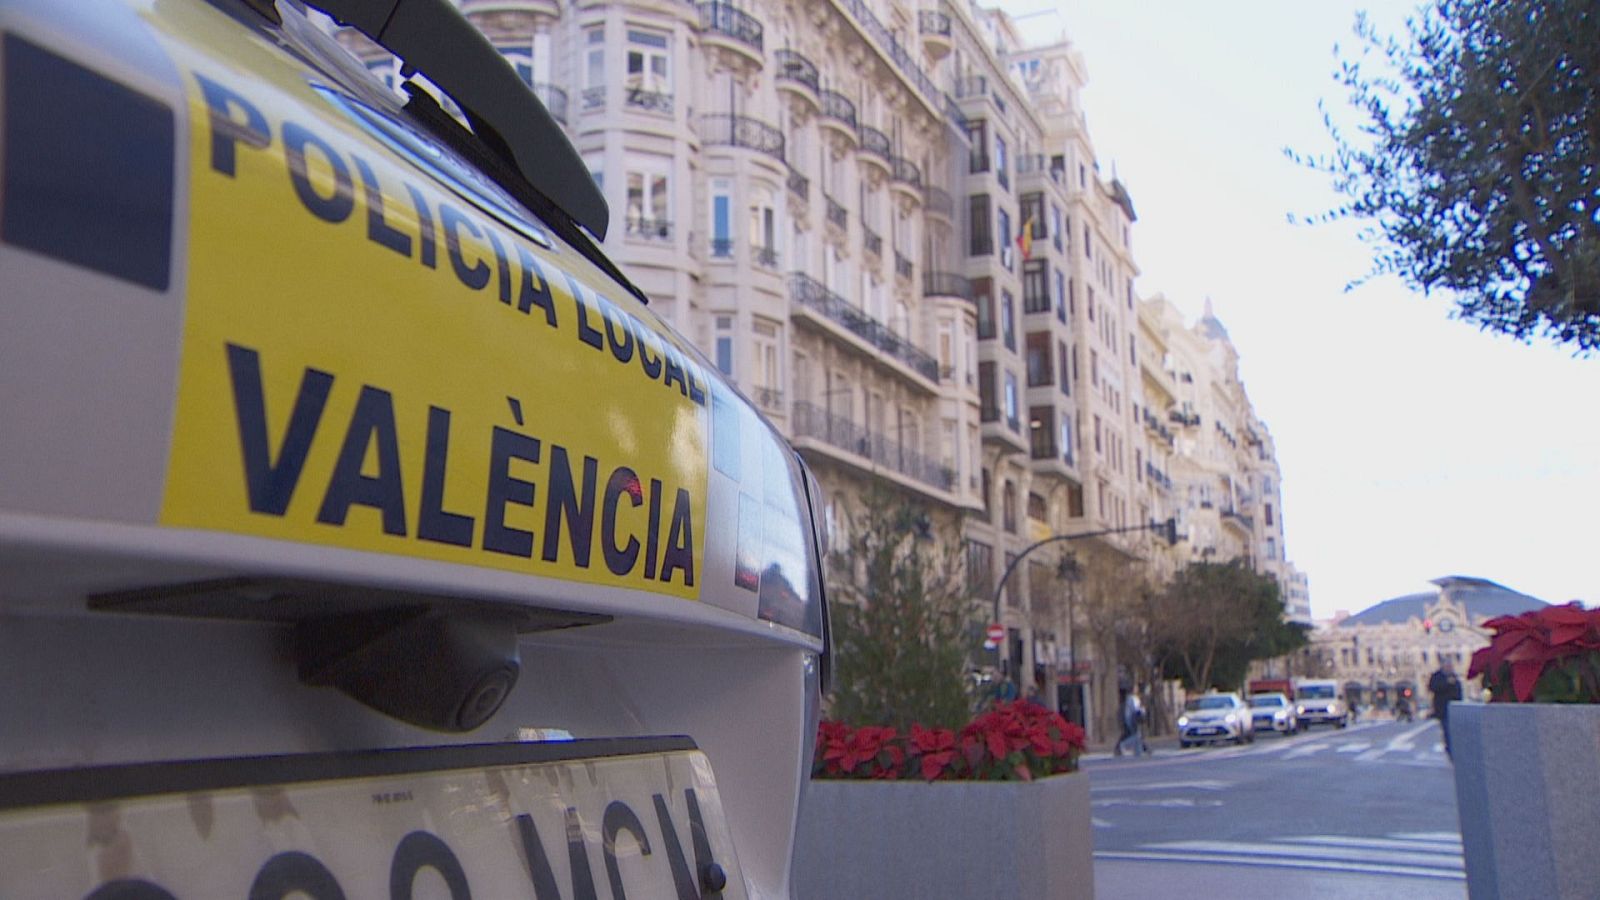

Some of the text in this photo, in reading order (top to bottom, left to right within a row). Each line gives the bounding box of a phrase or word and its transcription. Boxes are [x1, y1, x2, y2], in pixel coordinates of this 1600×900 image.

[192, 70, 706, 407] POLICIA LOCAL
[225, 341, 695, 588] VALÈNCIA
